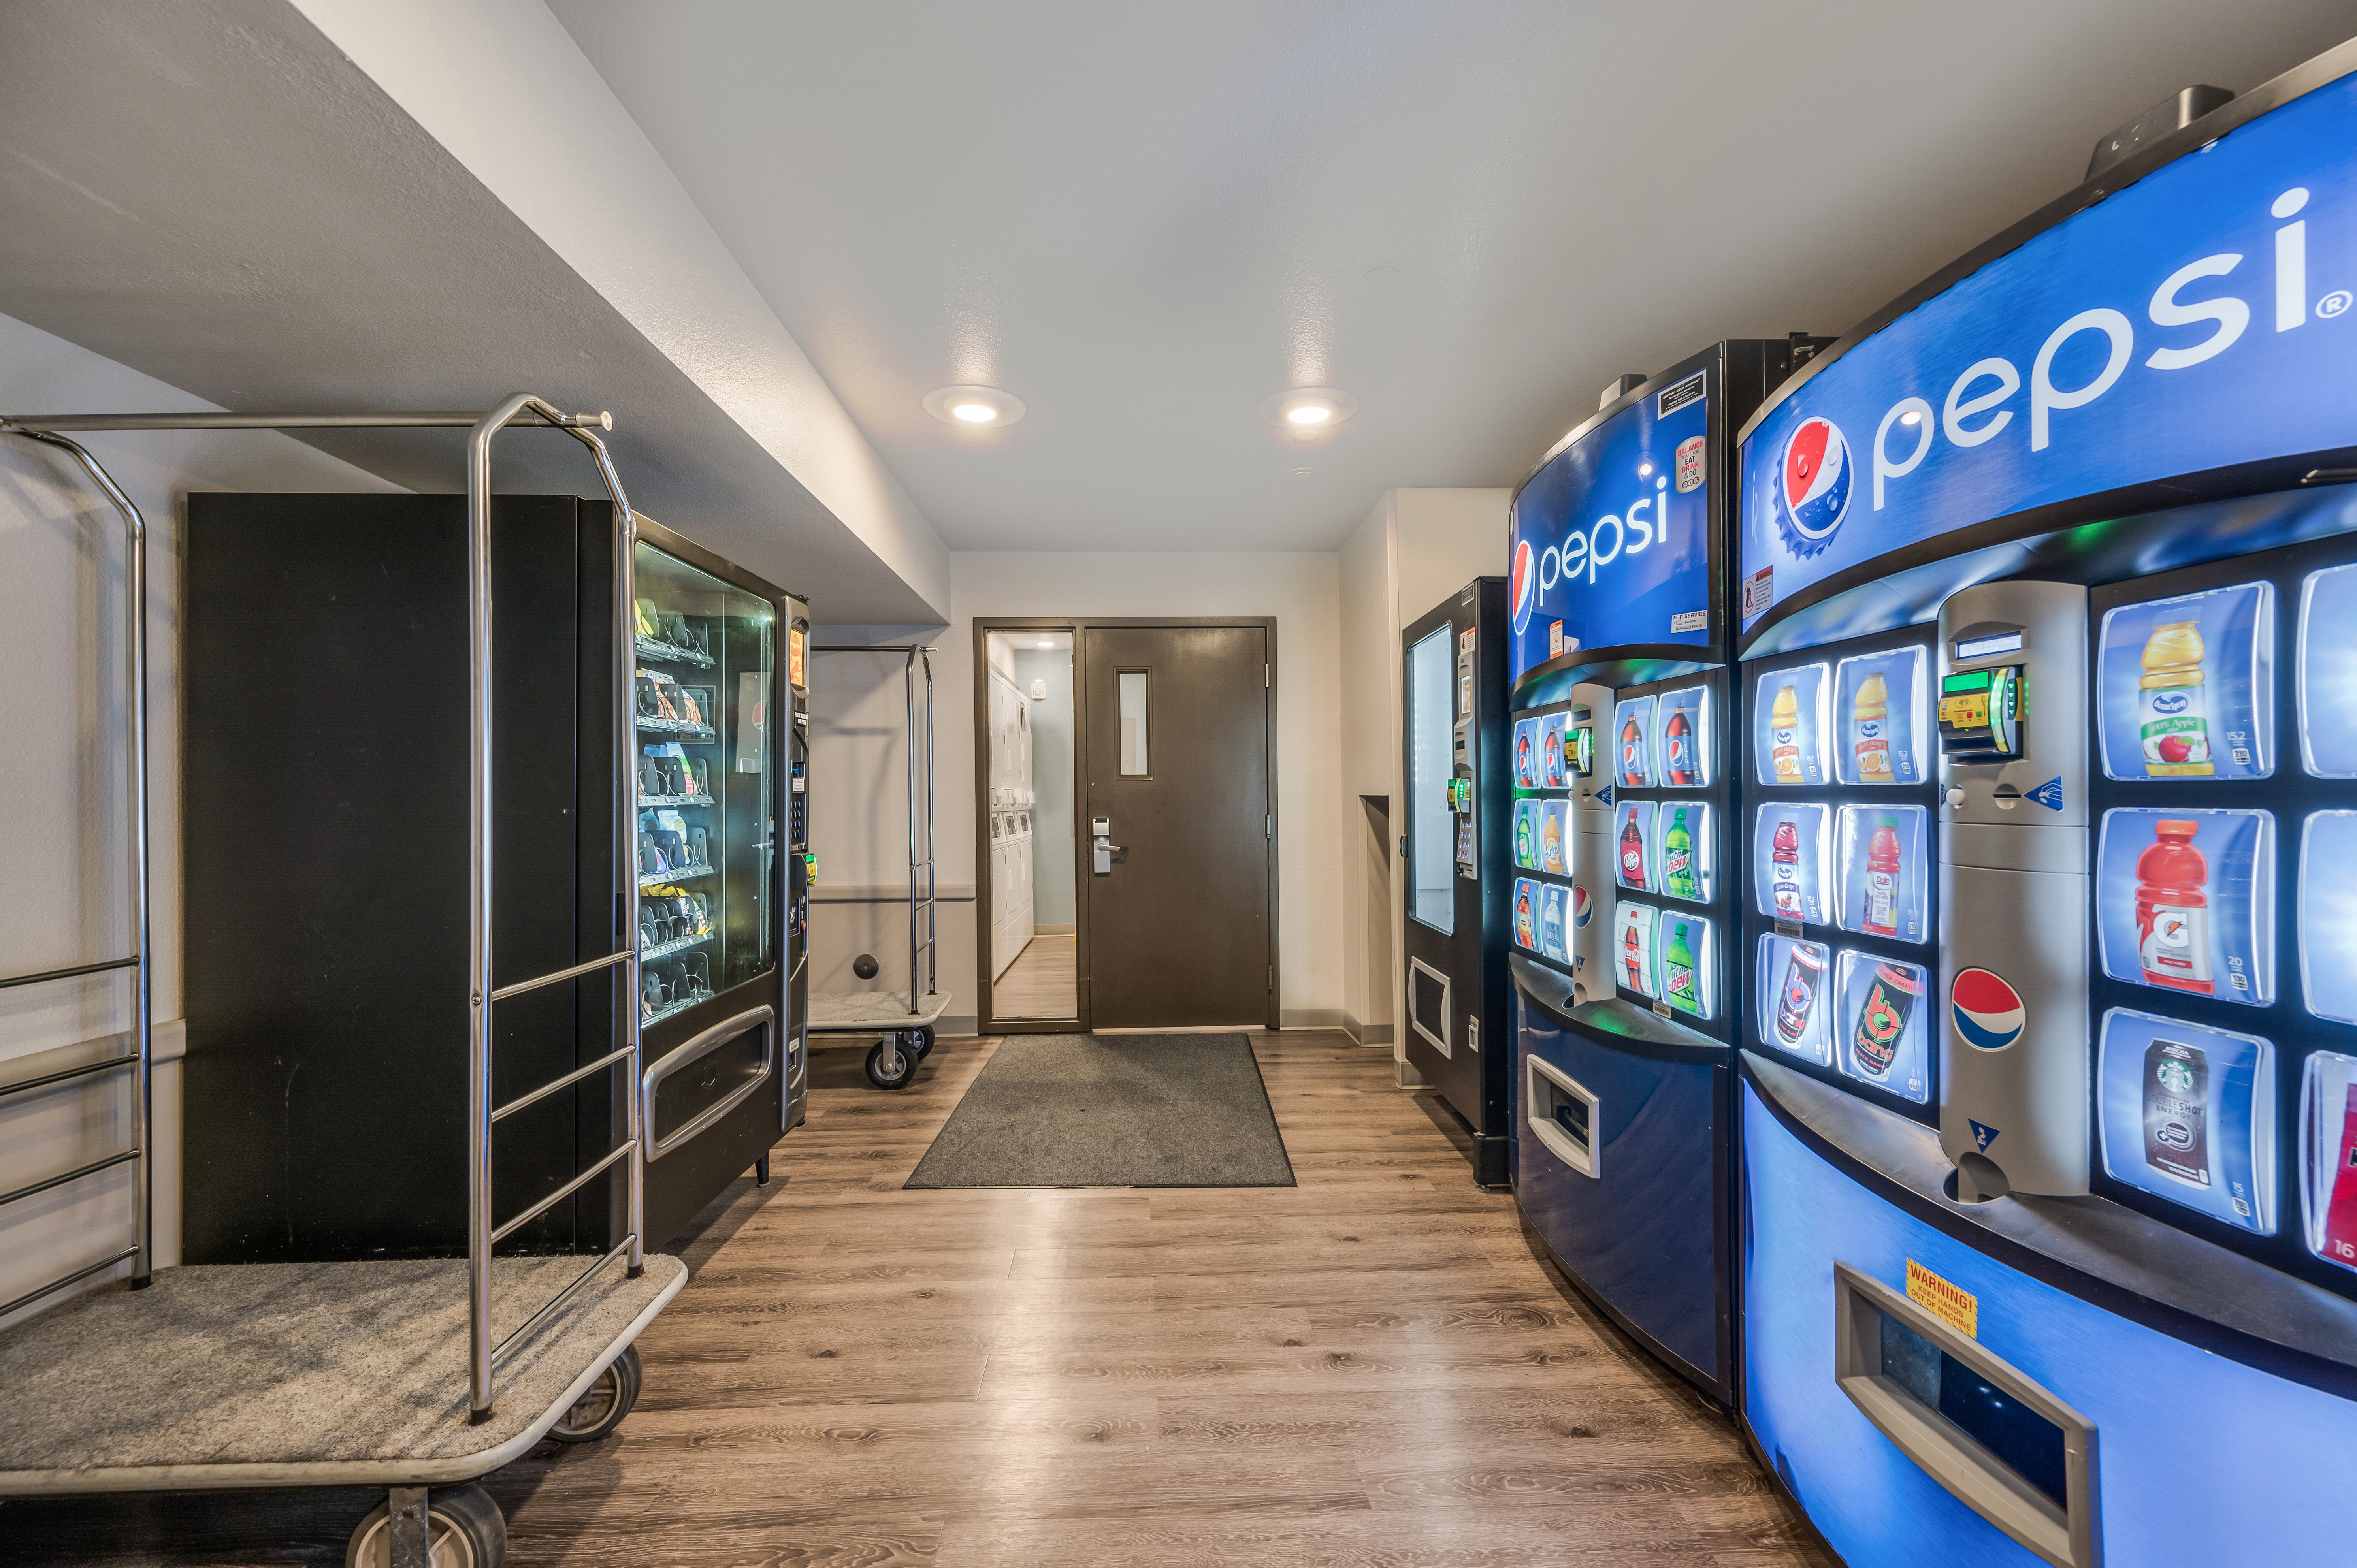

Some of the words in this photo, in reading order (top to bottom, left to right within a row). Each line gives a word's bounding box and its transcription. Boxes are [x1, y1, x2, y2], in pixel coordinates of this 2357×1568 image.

[1873, 187, 2310, 512] pepsi
[1678, 440, 1703, 456] BALANCE
[1682, 461, 1699, 473] DRINK
[1540, 476, 1667, 607] pepsi
[2154, 700, 2170, 710] Ocean
[2170, 699, 2186, 711] Spray
[2152, 721, 2170, 731] 100%
[2172, 719, 2195, 729] Apple
[1545, 842, 1560, 859] Sunkist
[1624, 854, 1638, 868] Pepper
[2153, 912, 2189, 948] G
[2228, 956, 2243, 966] 20
[1879, 969, 1892, 981] SUPER
[1857, 1026, 1893, 1062] bang
[2165, 1046, 2189, 1055] MOCHA
[1856, 1048, 1868, 1061] PEACH
[1869, 1059, 1886, 1069] MANGO
[2159, 1092, 2189, 1103] STARBUCKS
[2157, 1105, 2191, 1119] ENERGY
[2335, 1239, 2355, 1259] 16
[1911, 1265, 1972, 1313] WARNING!
[1918, 1285, 1936, 1299] KEEP
[1938, 1297, 1963, 1318] HANDS
[1911, 1289, 1925, 1301] OUT
[1927, 1299, 1936, 1308] OF
[1938, 1306, 1971, 1331] MACHINE
